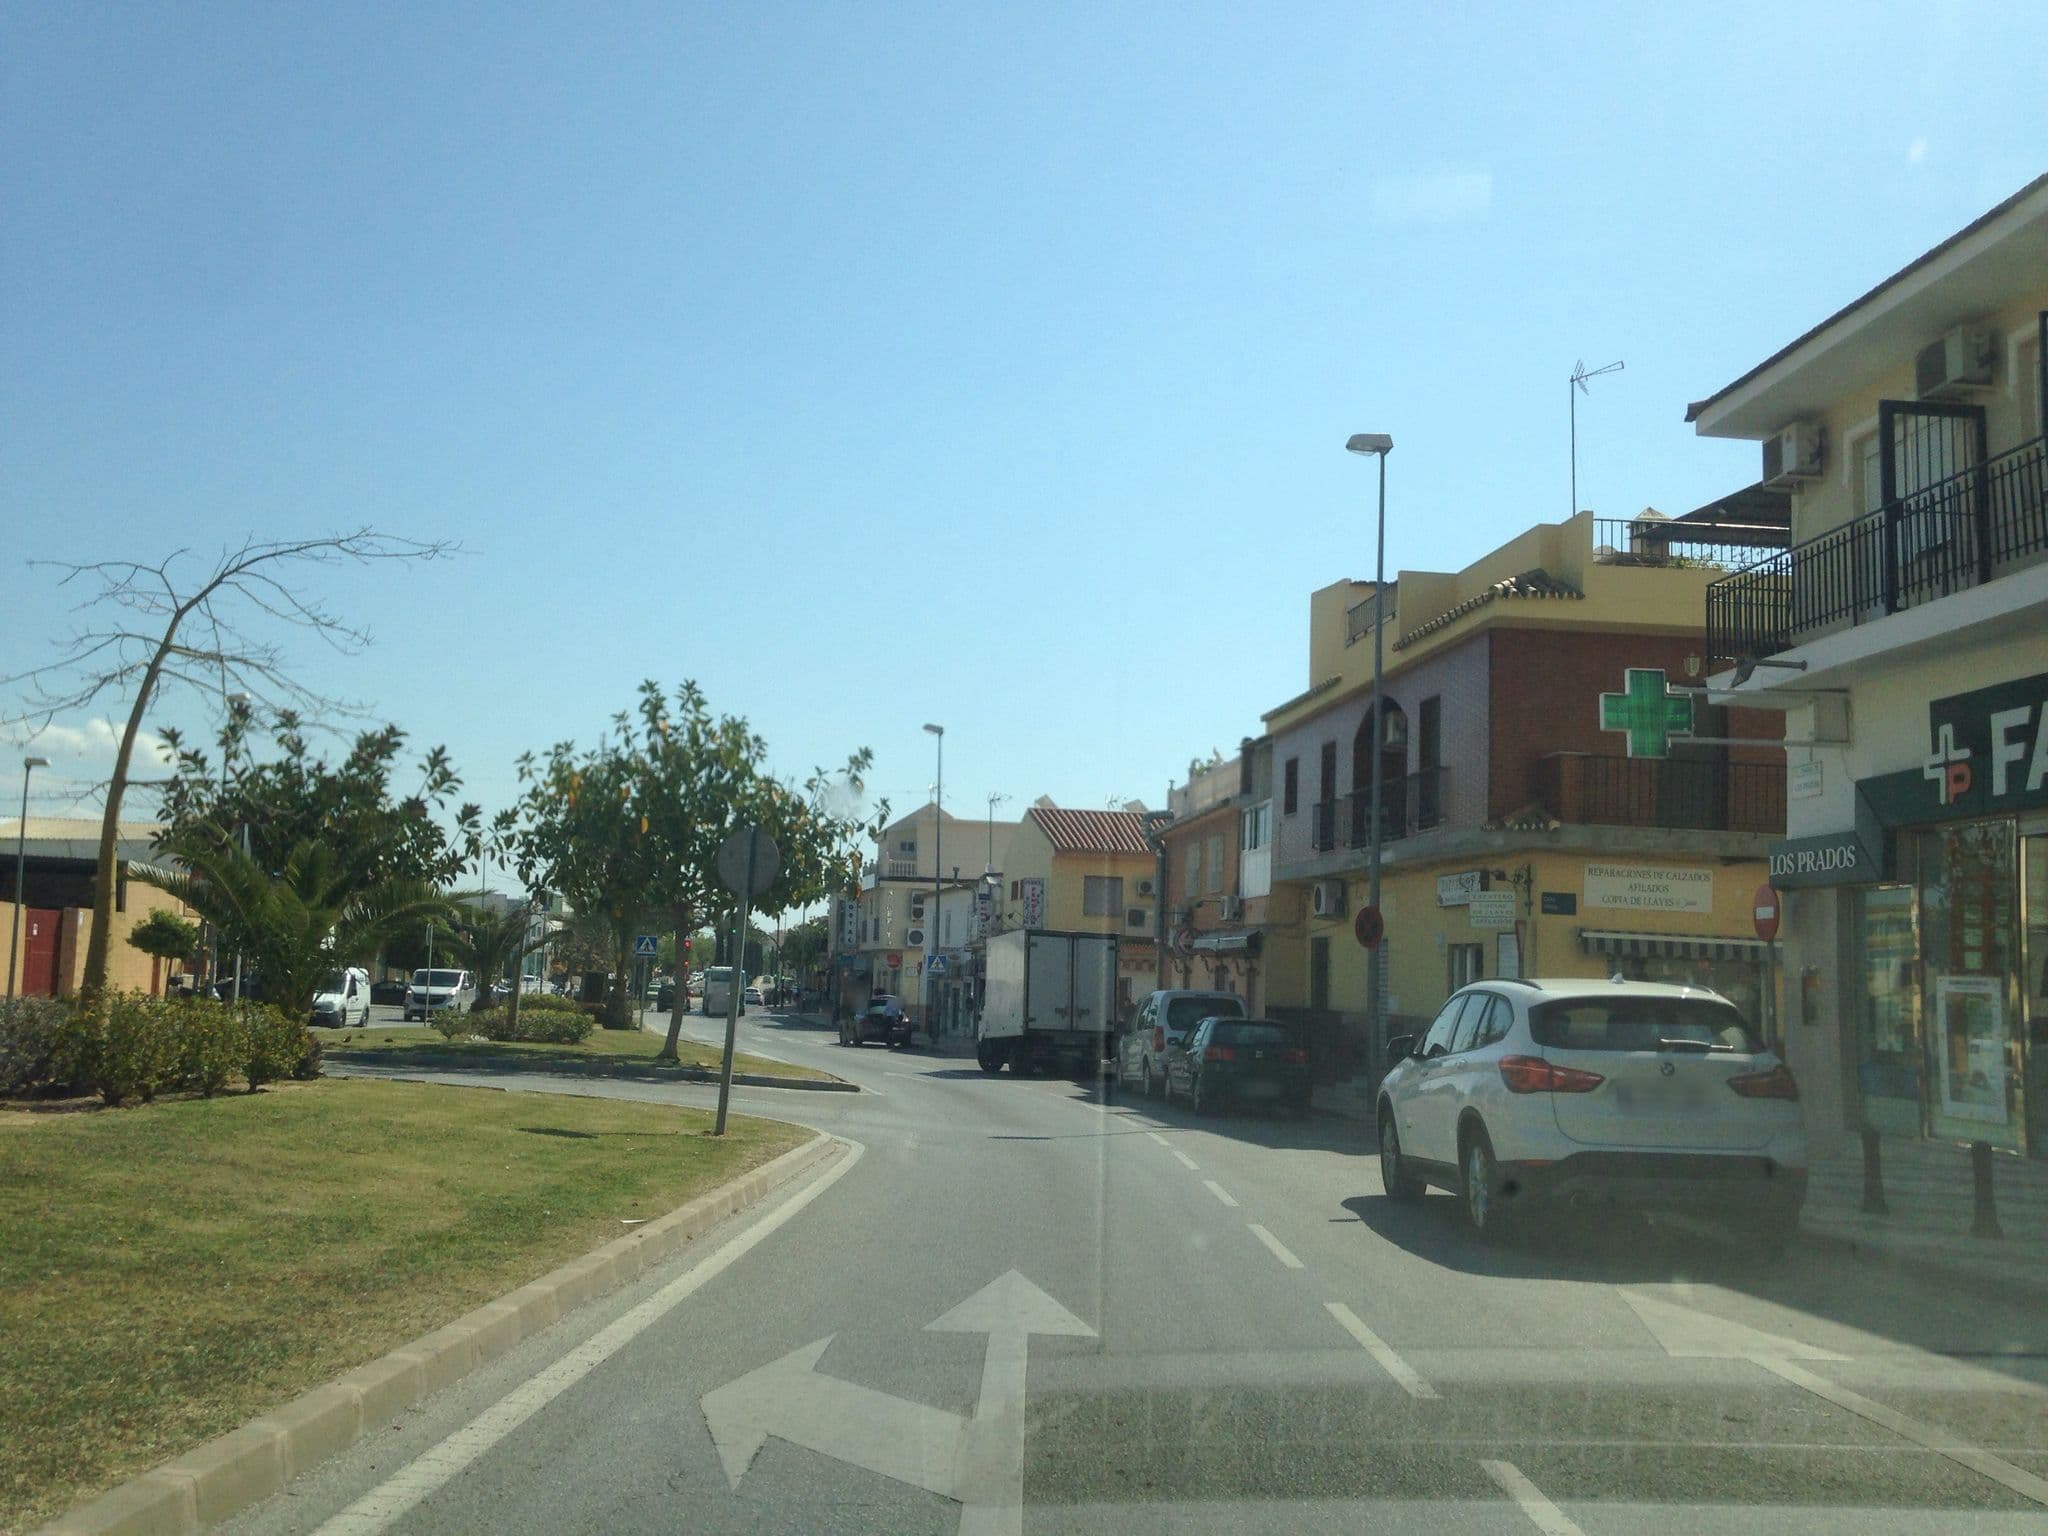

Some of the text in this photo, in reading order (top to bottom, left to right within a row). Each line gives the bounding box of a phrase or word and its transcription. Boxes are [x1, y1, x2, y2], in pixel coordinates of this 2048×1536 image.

[1769, 845, 1856, 876] LOS PRADOS
[1587, 867, 1711, 882] REPARACIONES DE CALZADOS
[1628, 883, 1670, 893] AFILADOS
[1601, 896, 1675, 907] COPIA DE LLAVES
